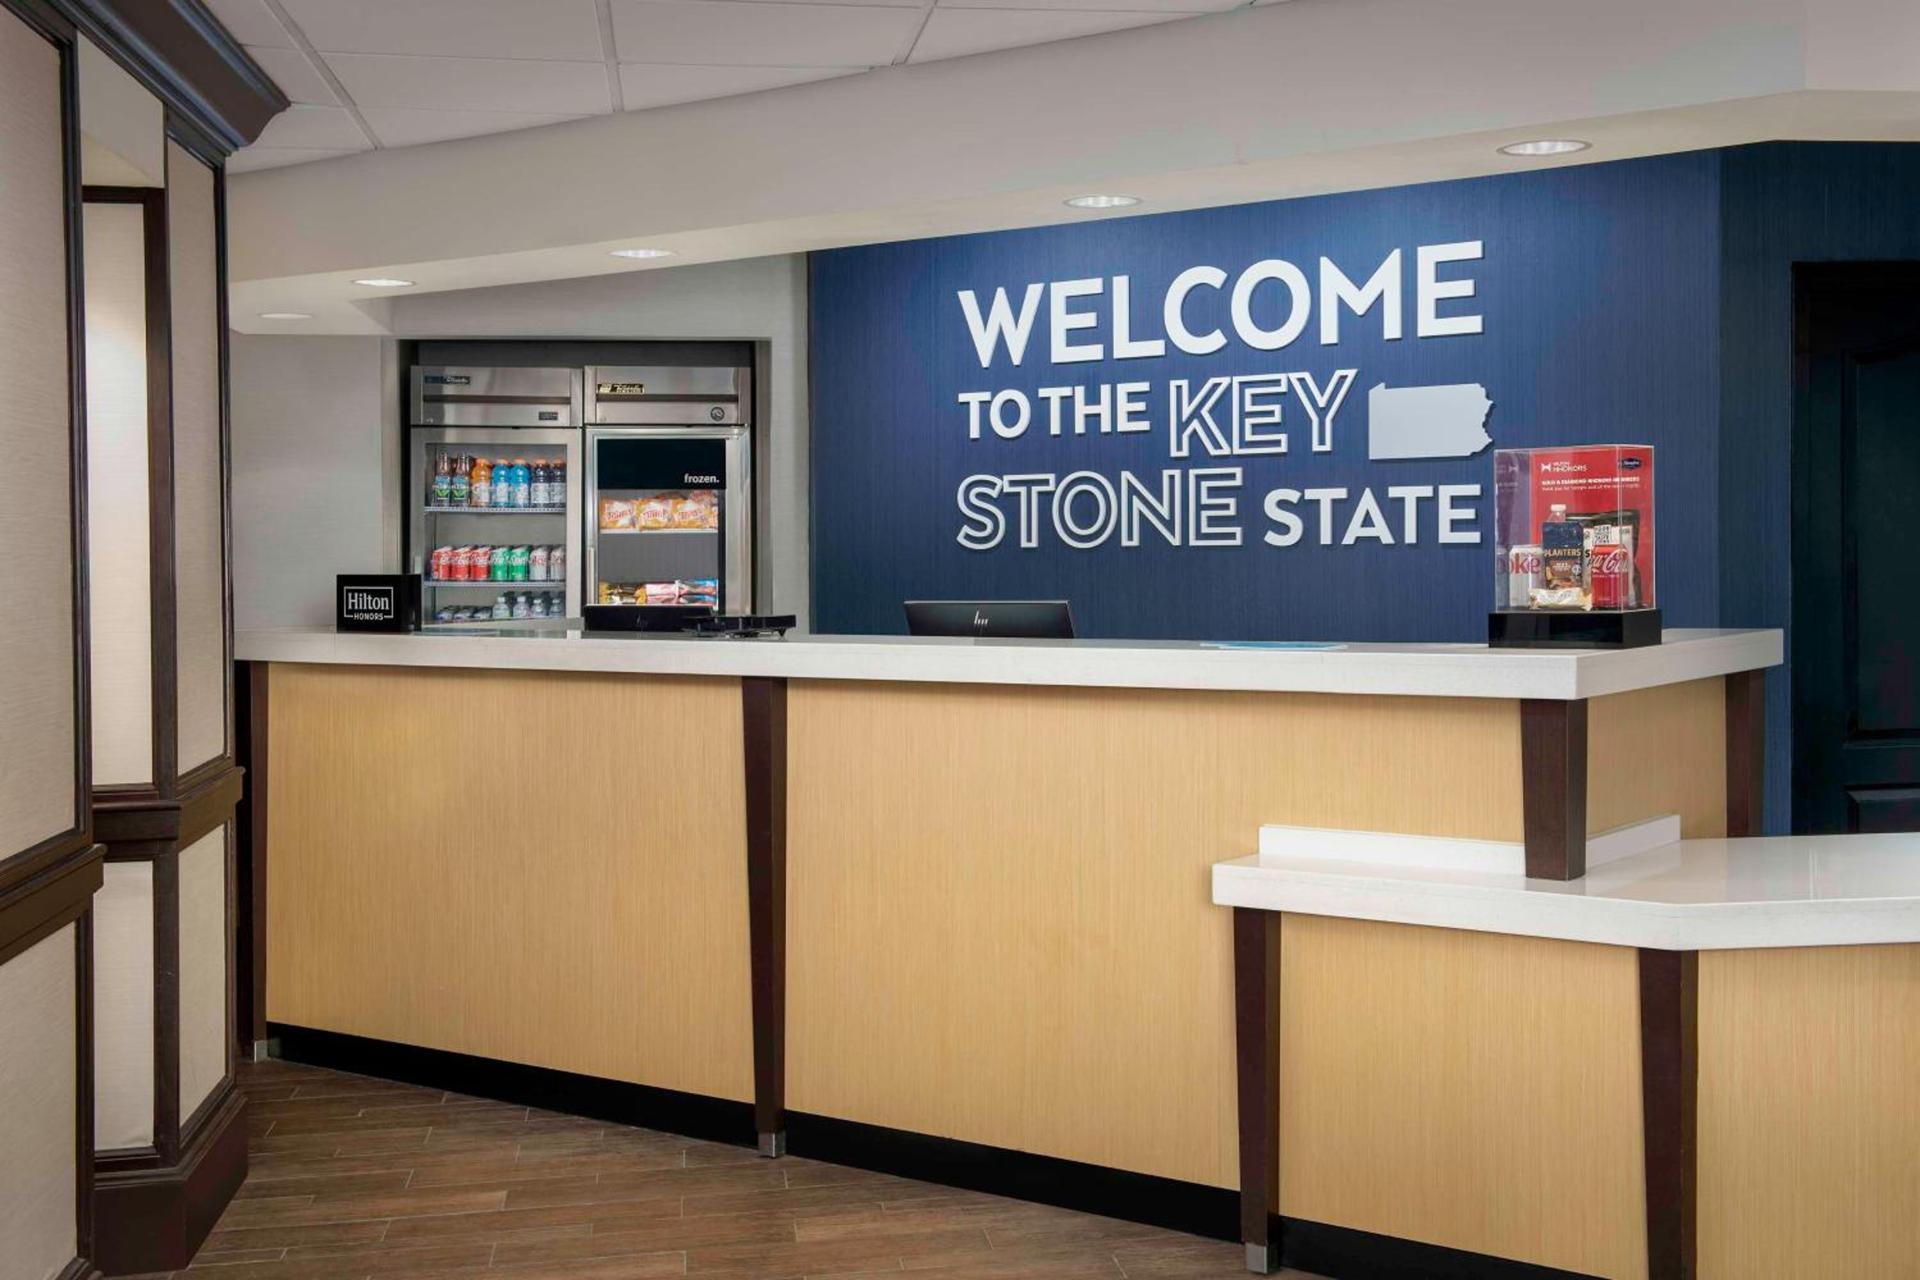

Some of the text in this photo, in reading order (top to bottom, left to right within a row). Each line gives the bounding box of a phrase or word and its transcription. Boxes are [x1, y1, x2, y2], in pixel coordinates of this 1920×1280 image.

[957, 240, 1484, 368] WELCOME
[957, 368, 1358, 458] TO THE KEY
[684, 473, 720, 484] frozen.
[956, 467, 1482, 550] STONE STATE
[347, 592, 390, 610] Hilton
[353, 612, 384, 621] HONORS
